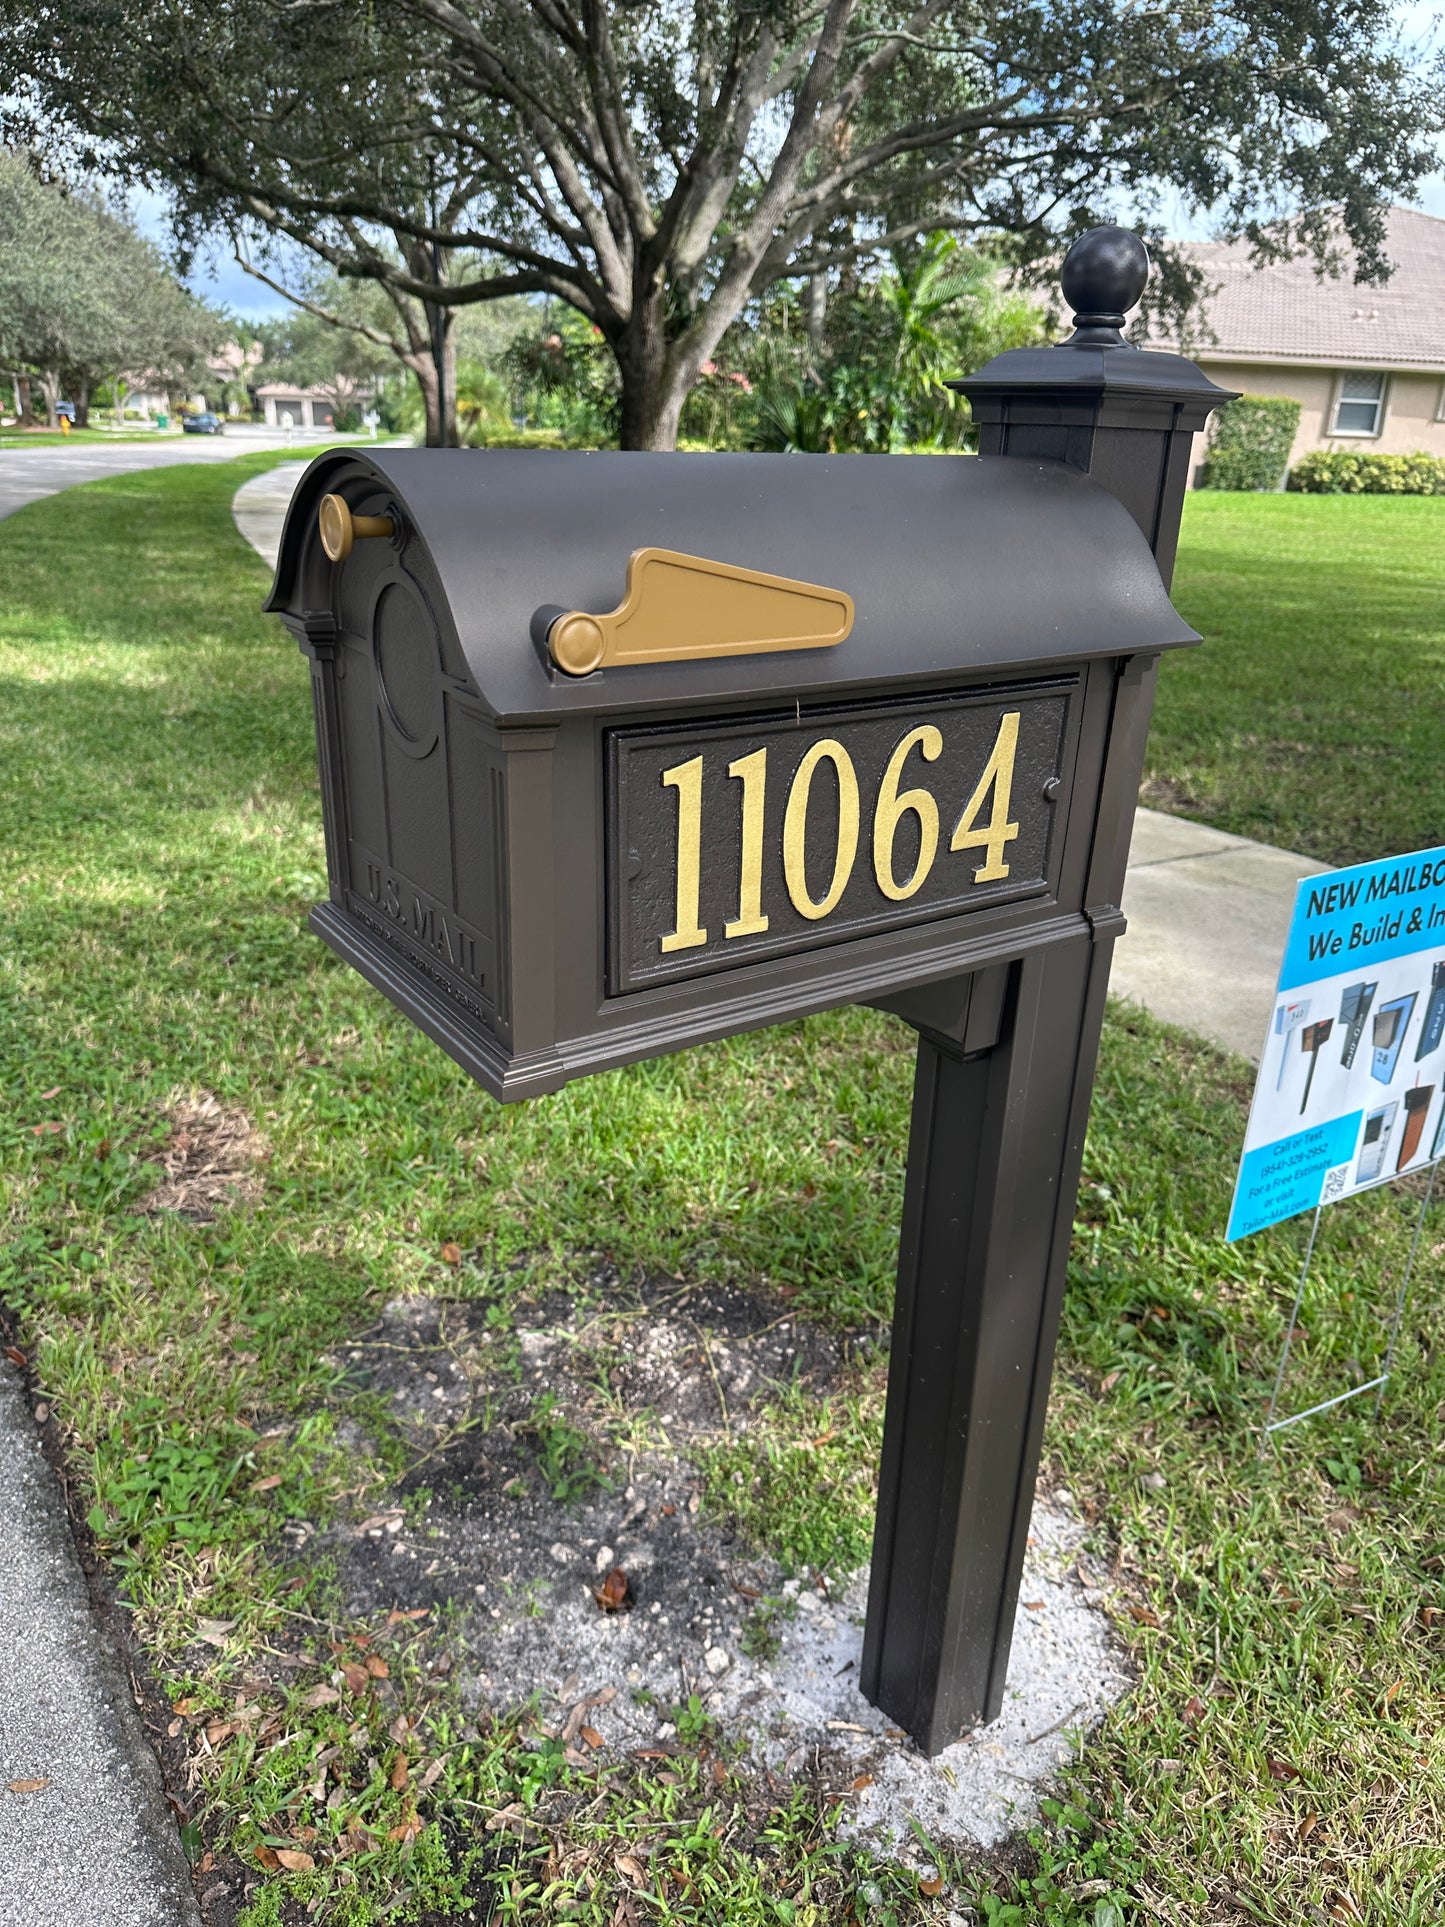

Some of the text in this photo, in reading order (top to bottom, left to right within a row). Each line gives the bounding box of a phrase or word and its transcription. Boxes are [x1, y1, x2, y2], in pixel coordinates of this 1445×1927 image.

[659, 711, 1020, 953] 11064
[1306, 878, 1365, 919] NEW
[411, 893, 484, 987] MAIL
[1309, 929, 1343, 961] We
[1348, 910, 1404, 950] Build
[1406, 906, 1423, 934] &
[1273, 1130, 1323, 1156] Call or Text
[1248, 1185, 1264, 1200] For
[1273, 1174, 1293, 1189] Free
[1294, 1159, 1332, 1180] Estimate
[1264, 1188, 1295, 1208] or visit
